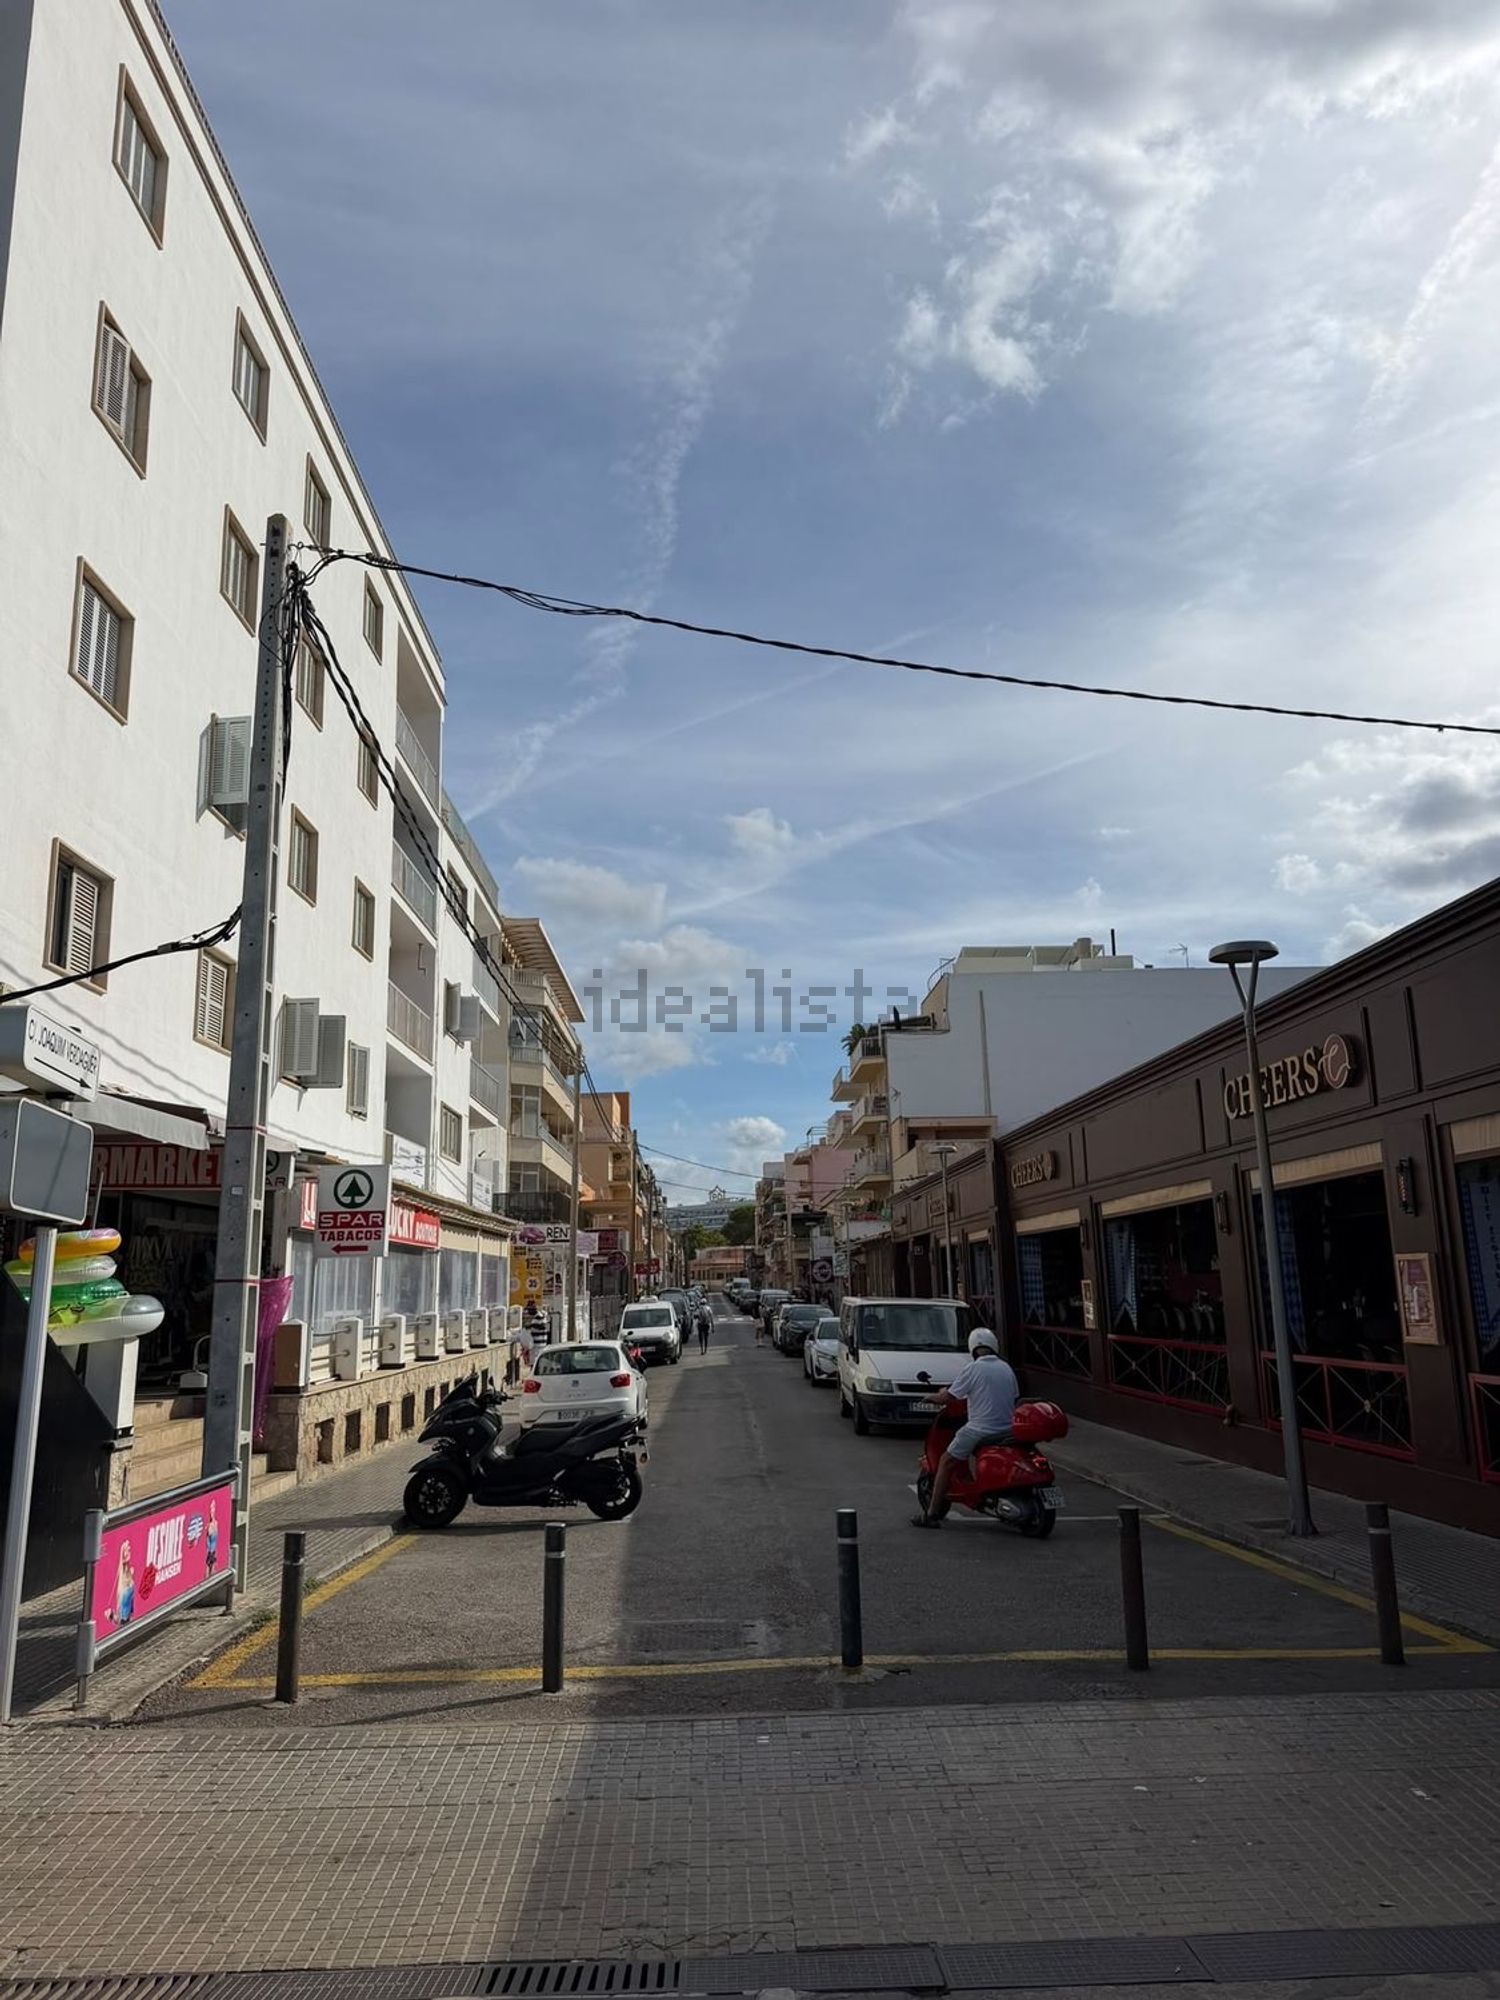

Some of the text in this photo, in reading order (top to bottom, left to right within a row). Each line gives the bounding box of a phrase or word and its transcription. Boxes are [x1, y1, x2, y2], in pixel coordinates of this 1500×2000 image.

[1223, 1046, 1319, 1120] CHEERS
[91, 1146, 224, 1185] RMARKET
[1010, 1154, 1044, 1188] CHEERS
[319, 1212, 384, 1227] SPAR
[319, 1229, 382, 1242] TABACOS
[388, 1202, 416, 1239] UCKY
[546, 1226, 570, 1239] REN
[146, 1513, 186, 1570] DESIREE
[154, 1559, 183, 1586] HANSEN
